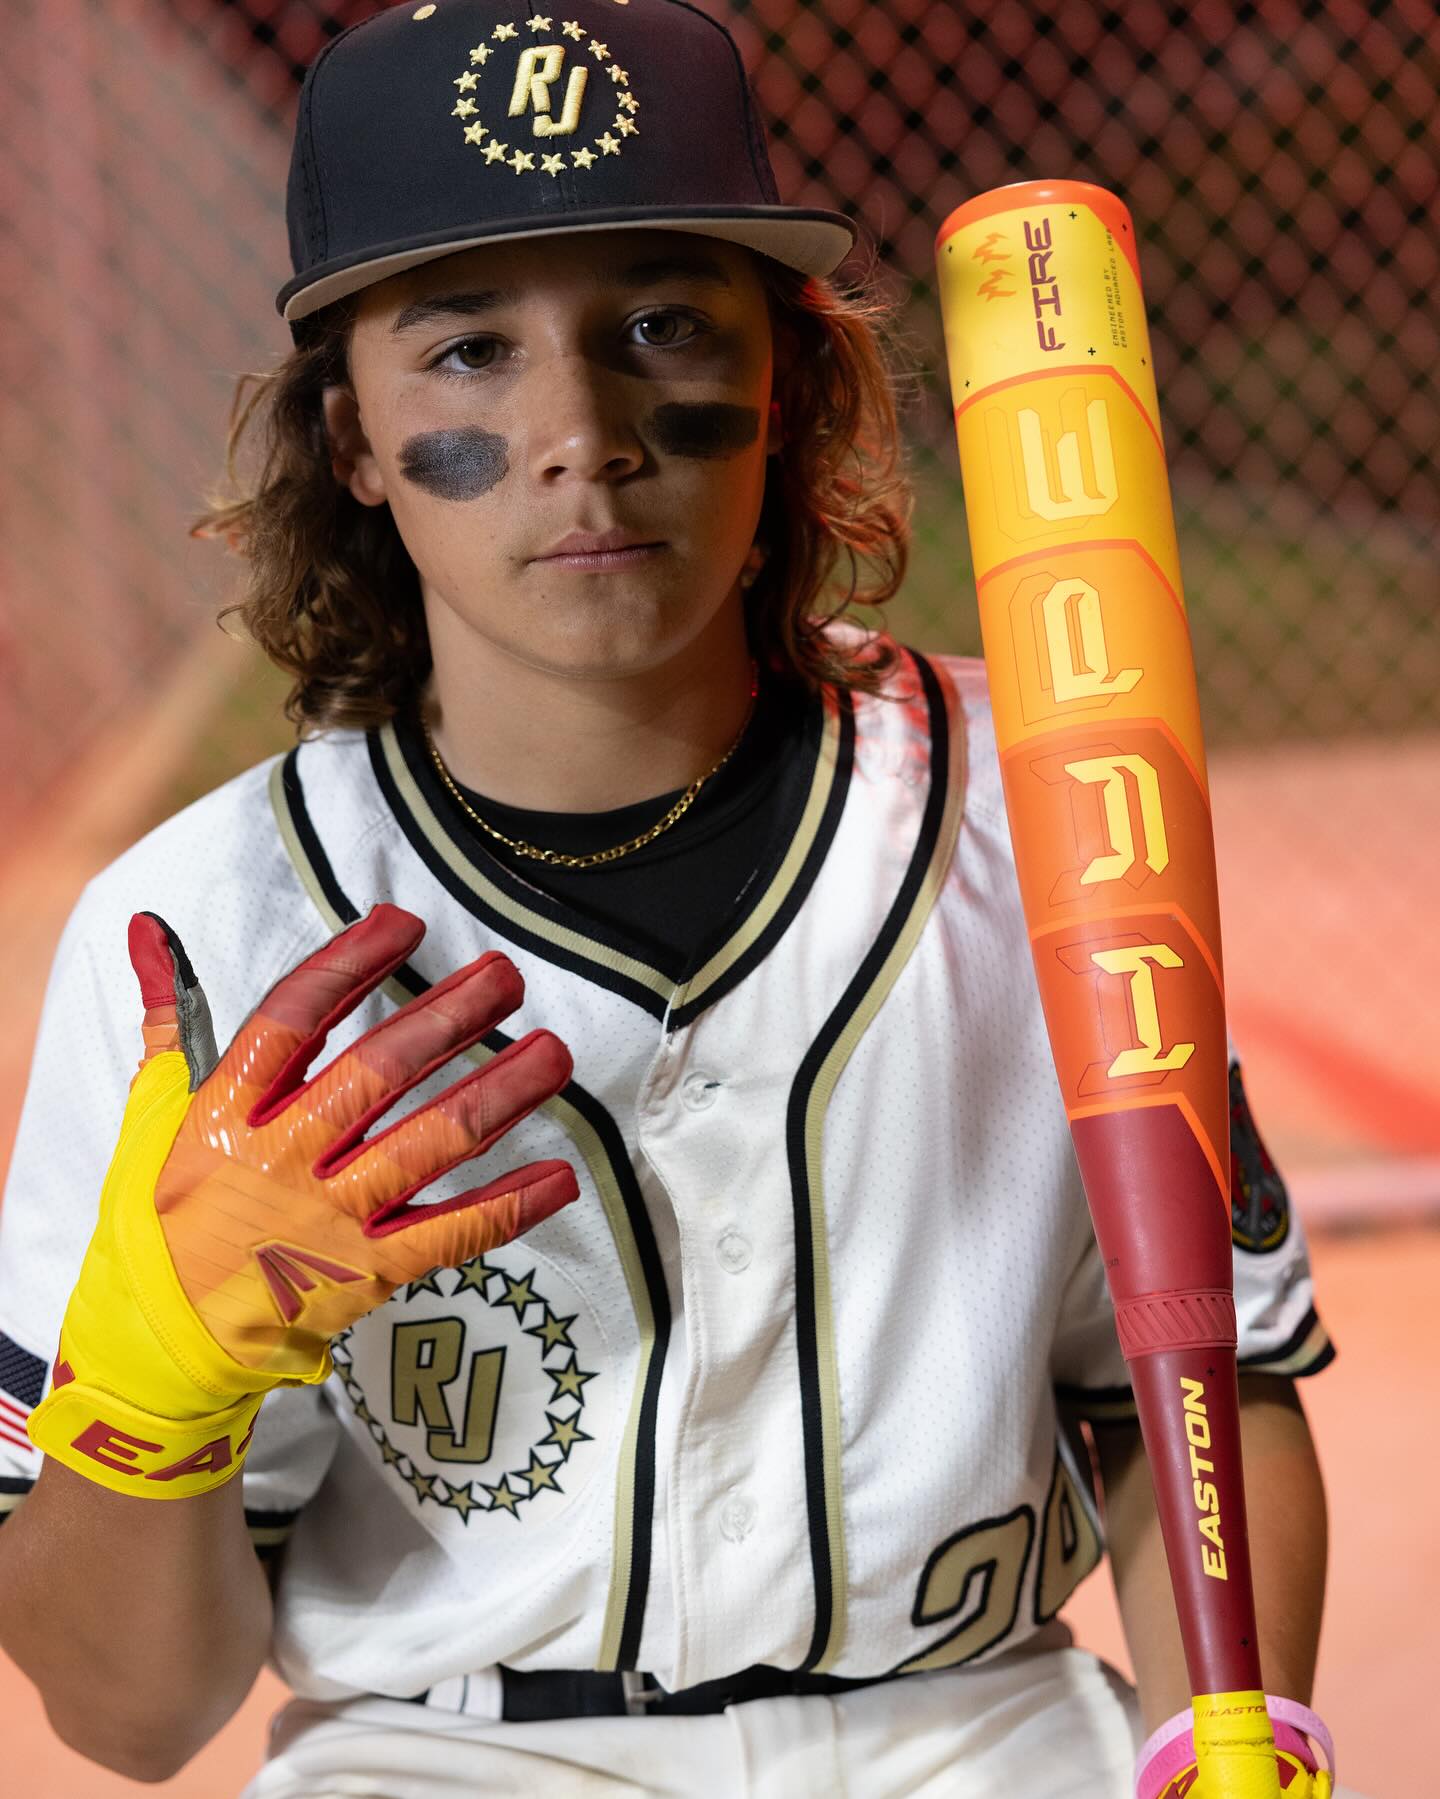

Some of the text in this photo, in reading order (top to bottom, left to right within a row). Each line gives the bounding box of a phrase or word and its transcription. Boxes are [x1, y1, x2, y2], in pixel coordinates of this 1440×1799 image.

[508, 45, 588, 137] RJ
[1023, 217, 1066, 352] FIRE
[1103, 268, 1120, 347] ENGINEERED BY
[1017, 398, 1195, 1079] HYPE
[391, 1316, 507, 1464] RJ
[1180, 1376, 1228, 1581] EASTON
